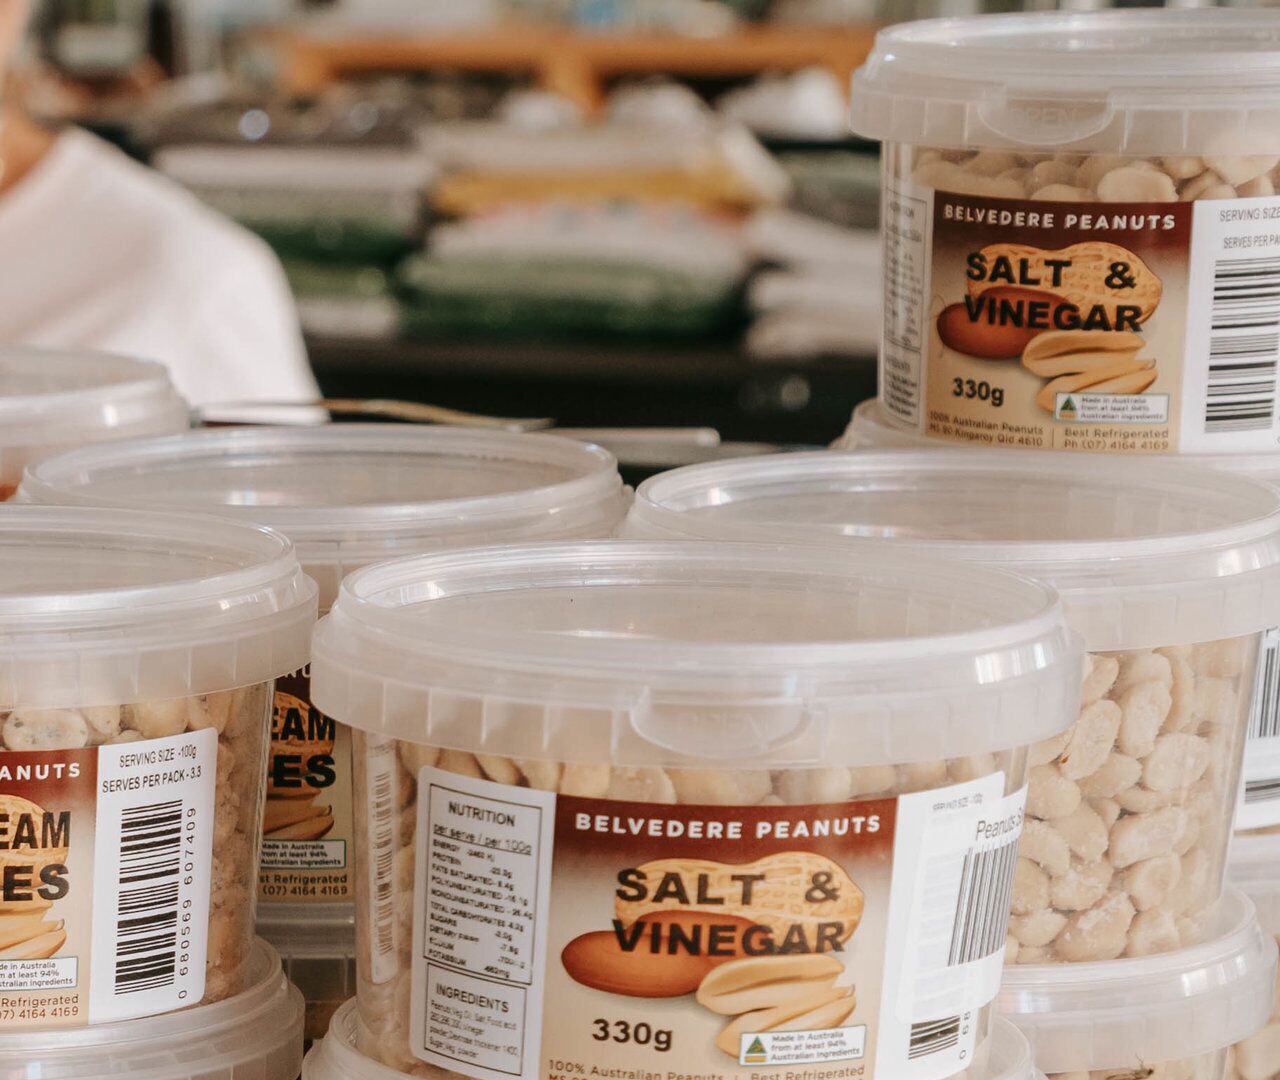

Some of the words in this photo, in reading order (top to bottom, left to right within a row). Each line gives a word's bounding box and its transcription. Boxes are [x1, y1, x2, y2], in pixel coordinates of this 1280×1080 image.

[944, 204, 1054, 228] BELVEDERE
[1064, 215, 1176, 231] PEANUTS
[1220, 208, 1260, 222] SERVING
[966, 252, 1072, 287] SALT
[1104, 261, 1137, 289] &
[964, 295, 1143, 331] VINEGAR
[953, 378, 1004, 406] 330g
[120, 750, 155, 768] SERVING
[158, 747, 175, 763] SIZE
[103, 776, 140, 794] SERVES
[142, 773, 160, 788] PER
[448, 801, 515, 826] NUTRITION
[576, 813, 742, 840] BELVEDERE
[757, 816, 880, 838] PEANUTS
[184, 808, 196, 886] 607409
[274, 875, 347, 885] Refrigerated
[616, 868, 765, 906] SALT
[805, 871, 840, 904] &
[179, 900, 192, 976] 680569
[612, 919, 845, 957] VINEGAR
[0, 994, 79, 1009] Refrigerated
[436, 983, 509, 1013] INGREDIENTS
[18, 1008, 46, 1019] 4164
[49, 1007, 79, 1017] 4169
[592, 1019, 672, 1051] 330g
